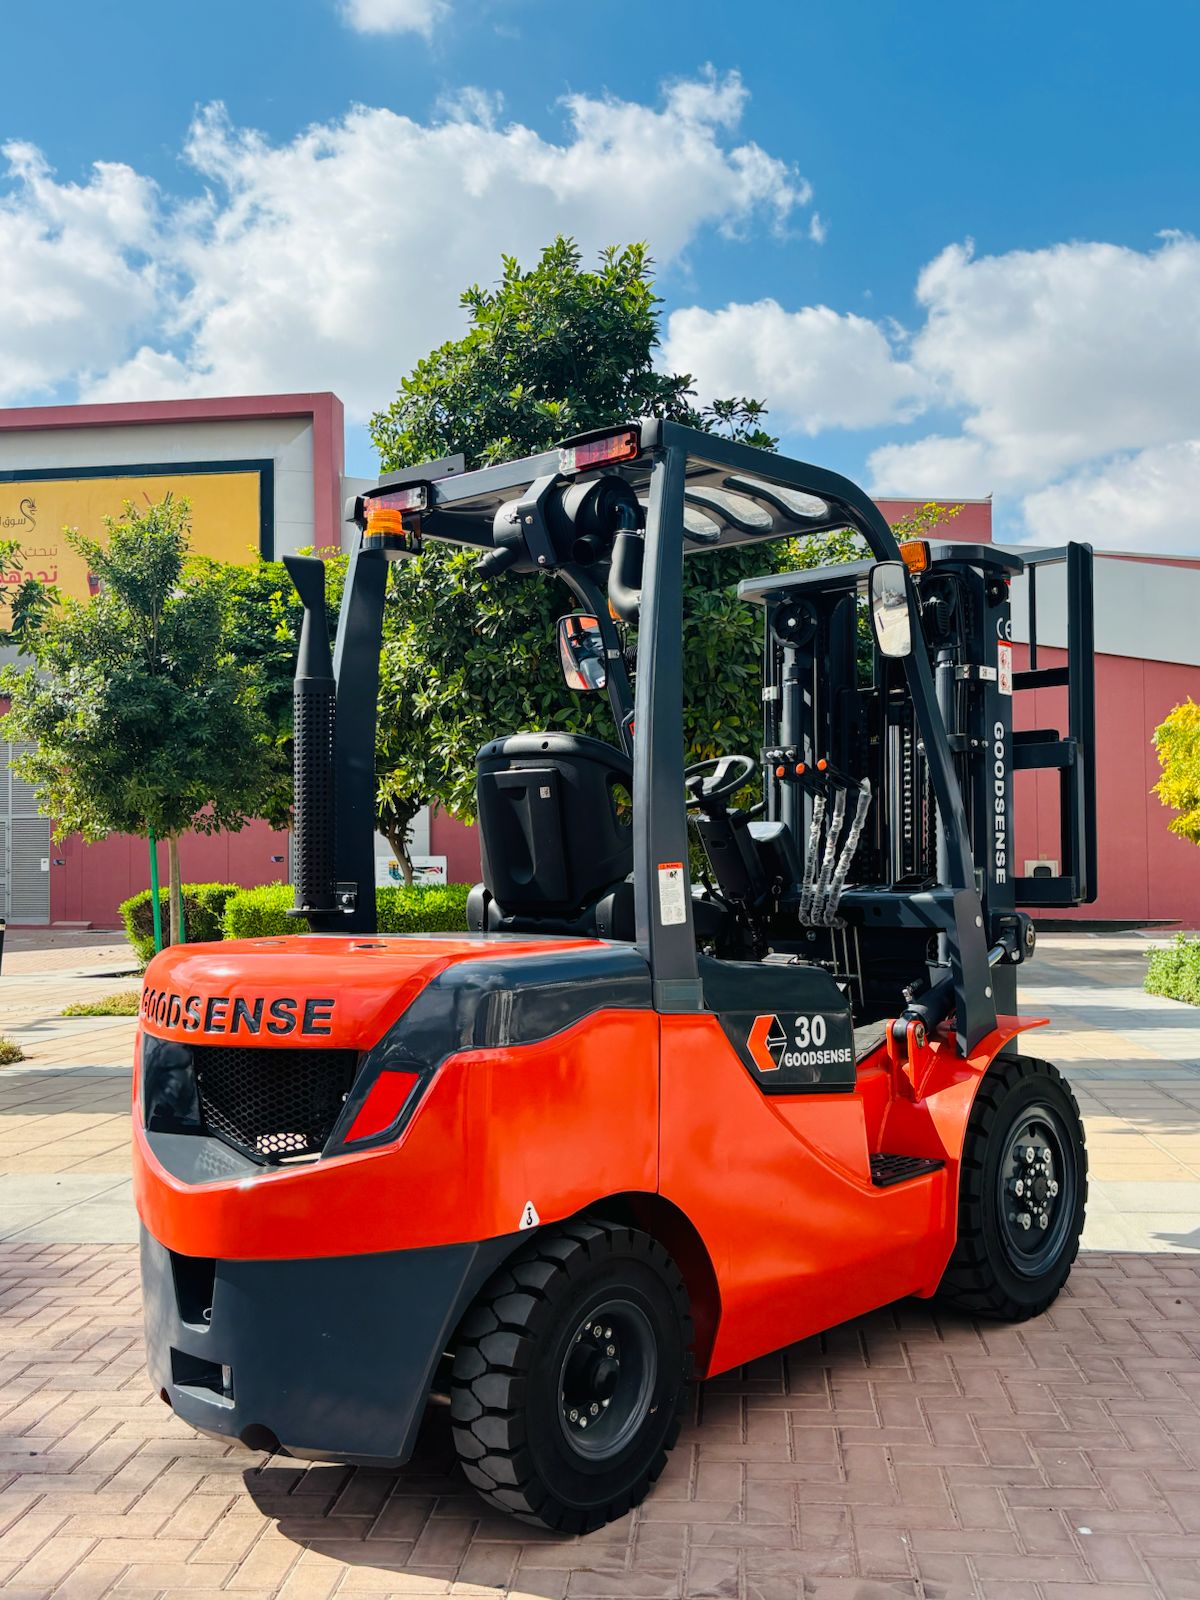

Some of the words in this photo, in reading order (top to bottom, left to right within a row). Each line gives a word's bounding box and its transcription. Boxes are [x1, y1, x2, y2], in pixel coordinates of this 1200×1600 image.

[994, 721, 1006, 884] GOODSENSE
[142, 986, 335, 1035] GOODSENSE
[795, 1015, 826, 1048] 30
[784, 1048, 851, 1067] GOODSENSE
